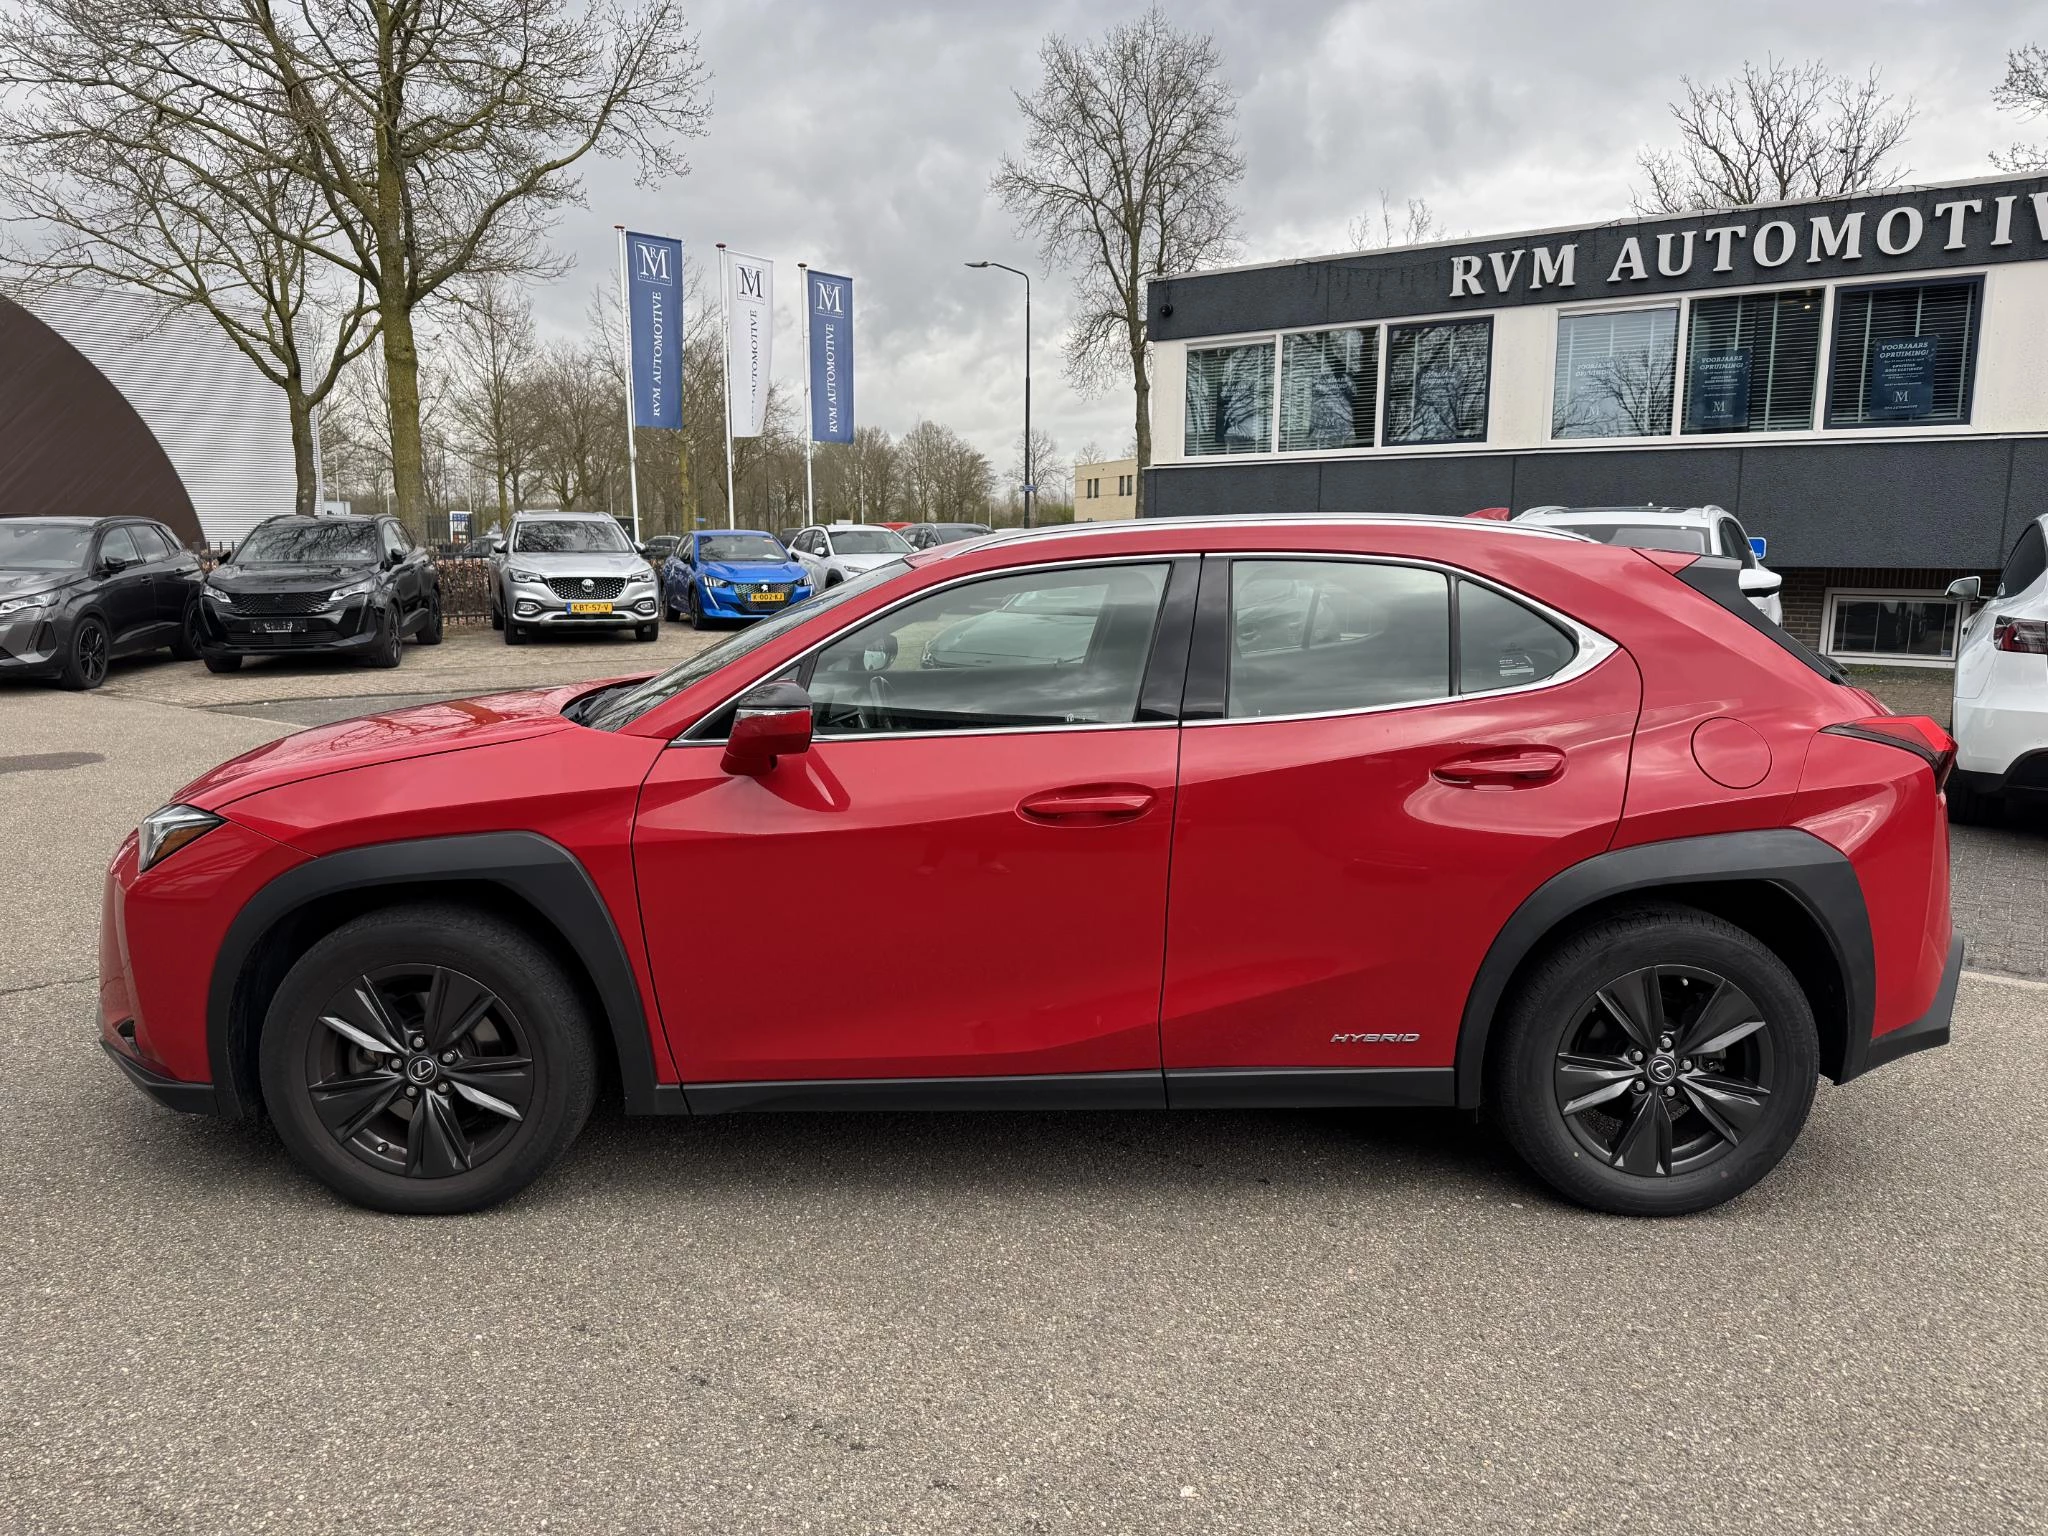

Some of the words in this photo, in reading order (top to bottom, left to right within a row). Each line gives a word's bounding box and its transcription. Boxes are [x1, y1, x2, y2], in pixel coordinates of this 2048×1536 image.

[1449, 243, 1578, 297] RVM
[652, 291, 663, 385] AUTOMOTIVE
[1881, 342, 1929, 351] VOORJAARS
[825, 323, 837, 406] AUTOMOTIVE
[1879, 349, 1929, 359] OPRUIMING!
[653, 387, 663, 417] RVM
[829, 407, 838, 433] RVM
[573, 603, 609, 611] KBT-57-V
[1330, 1033, 1420, 1042] HYBRID
